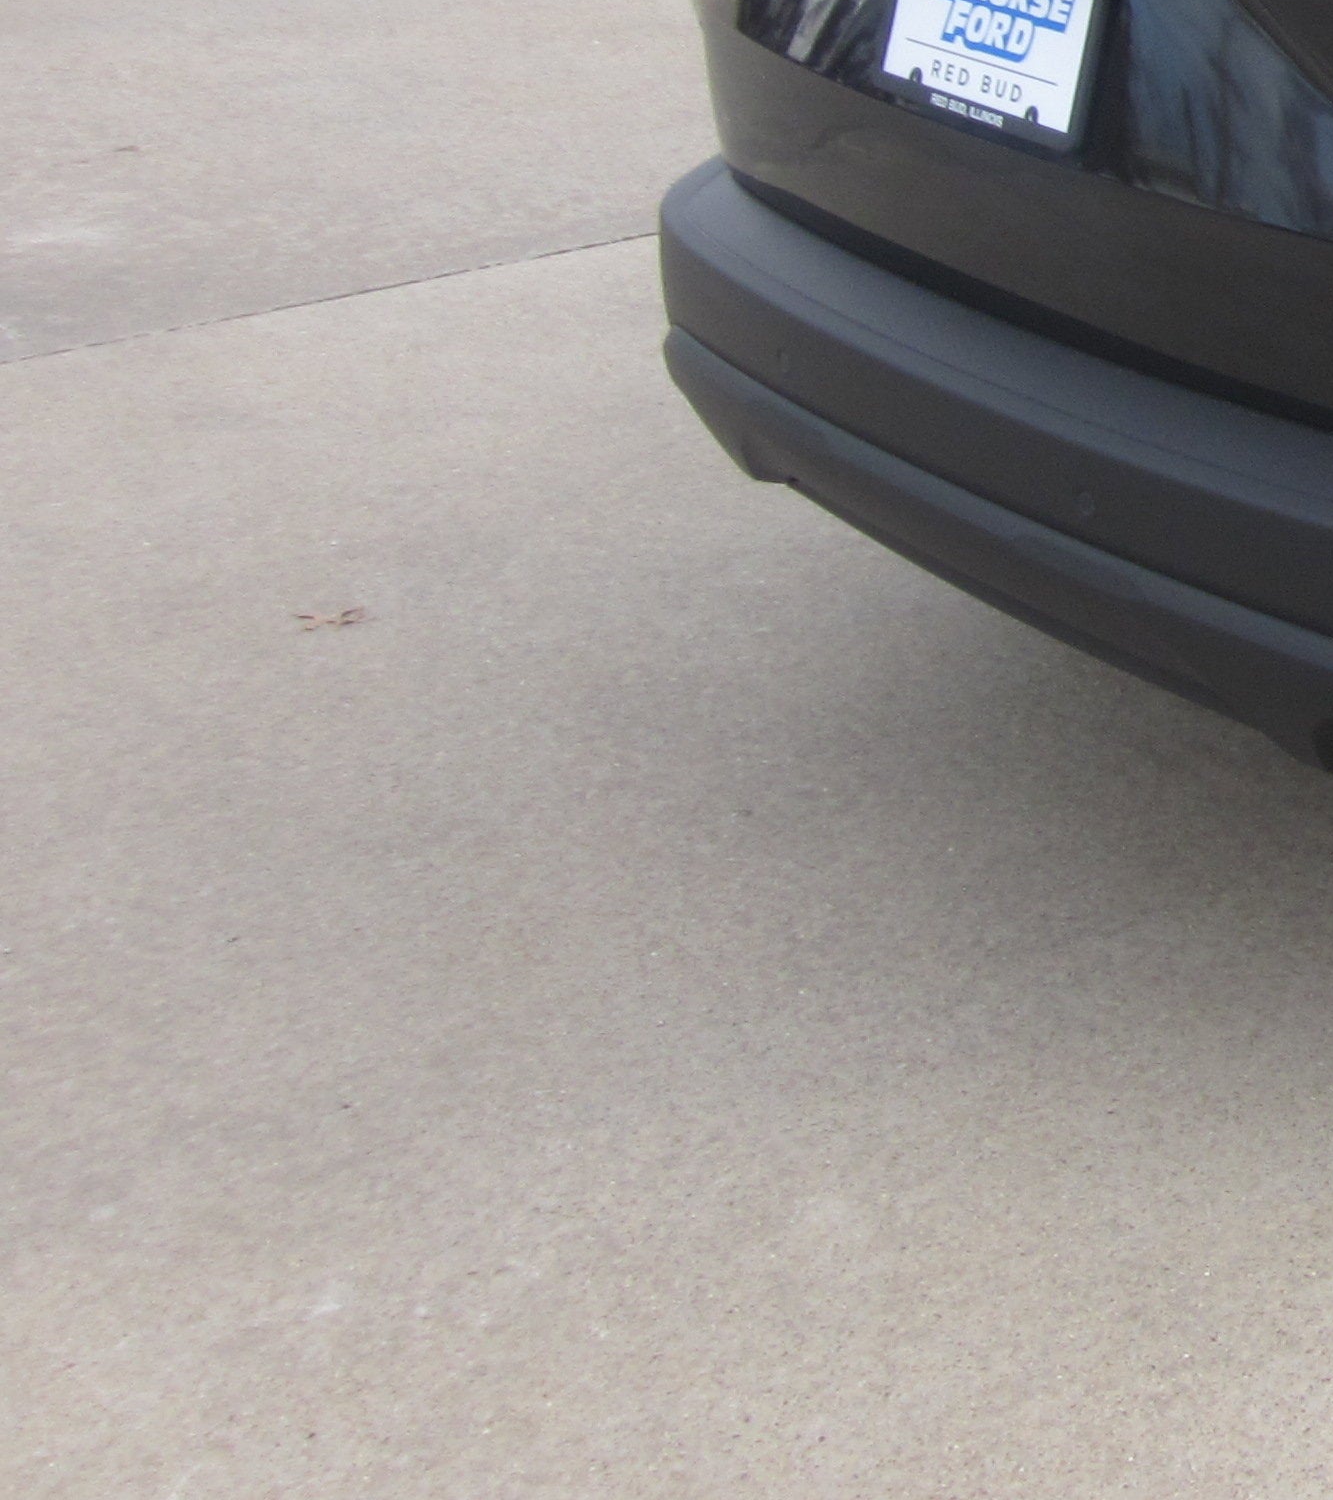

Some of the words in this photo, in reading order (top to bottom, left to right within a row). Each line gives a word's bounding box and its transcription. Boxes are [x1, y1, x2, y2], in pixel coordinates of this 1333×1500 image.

[941, 0, 1036, 62] FORD
[930, 59, 970, 86] RED
[981, 75, 1023, 102] BUD
